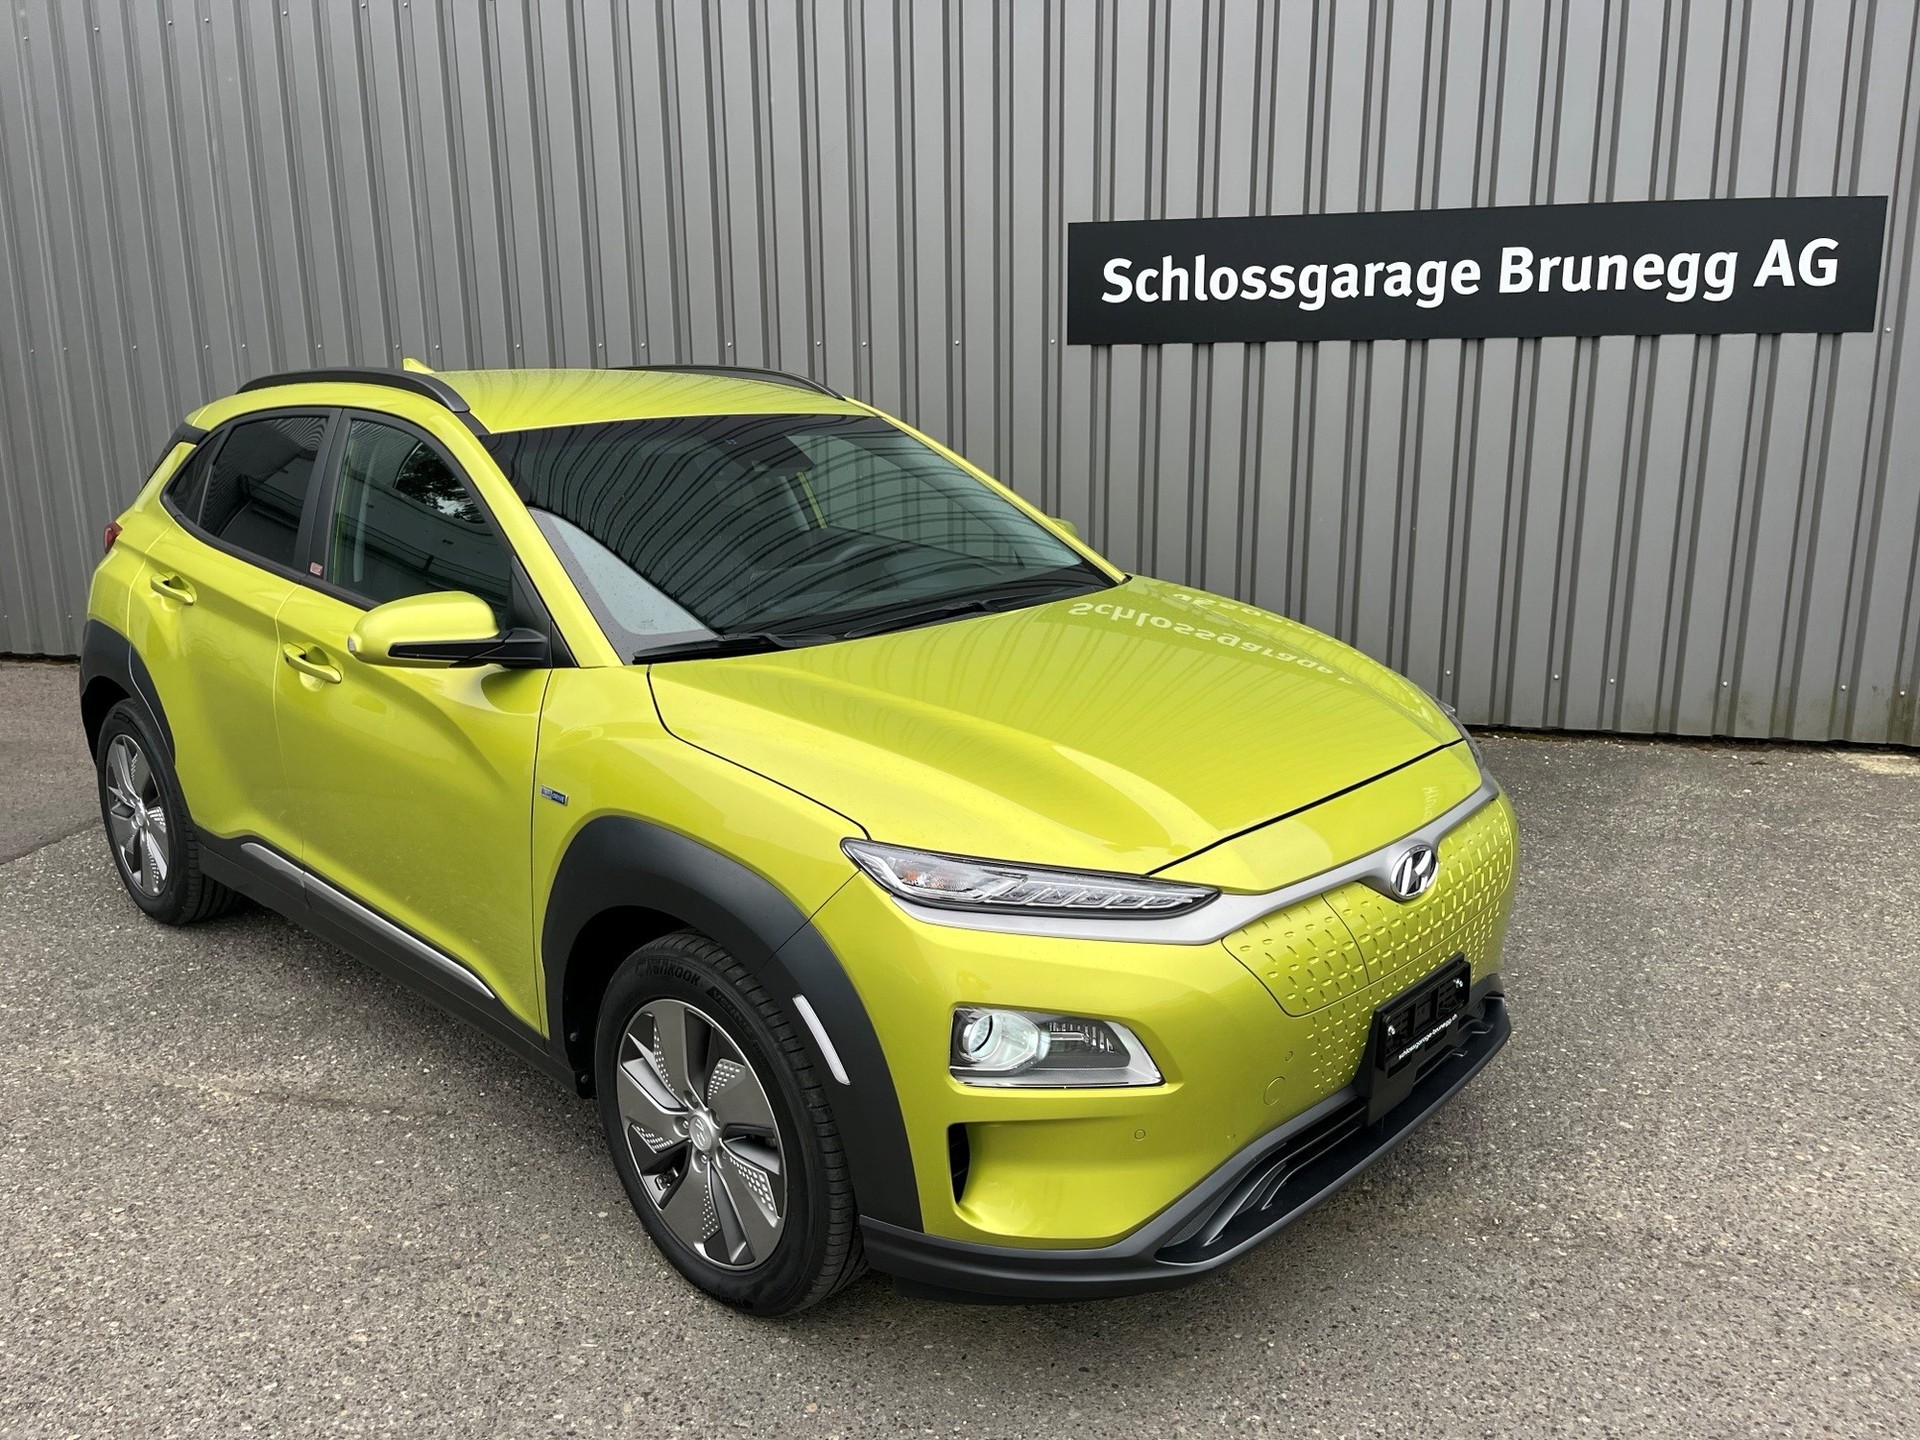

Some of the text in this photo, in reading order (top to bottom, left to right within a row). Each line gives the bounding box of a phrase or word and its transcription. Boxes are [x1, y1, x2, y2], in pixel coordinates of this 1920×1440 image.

[1101, 237, 1839, 311] Schlossgarage Brunegg AG
